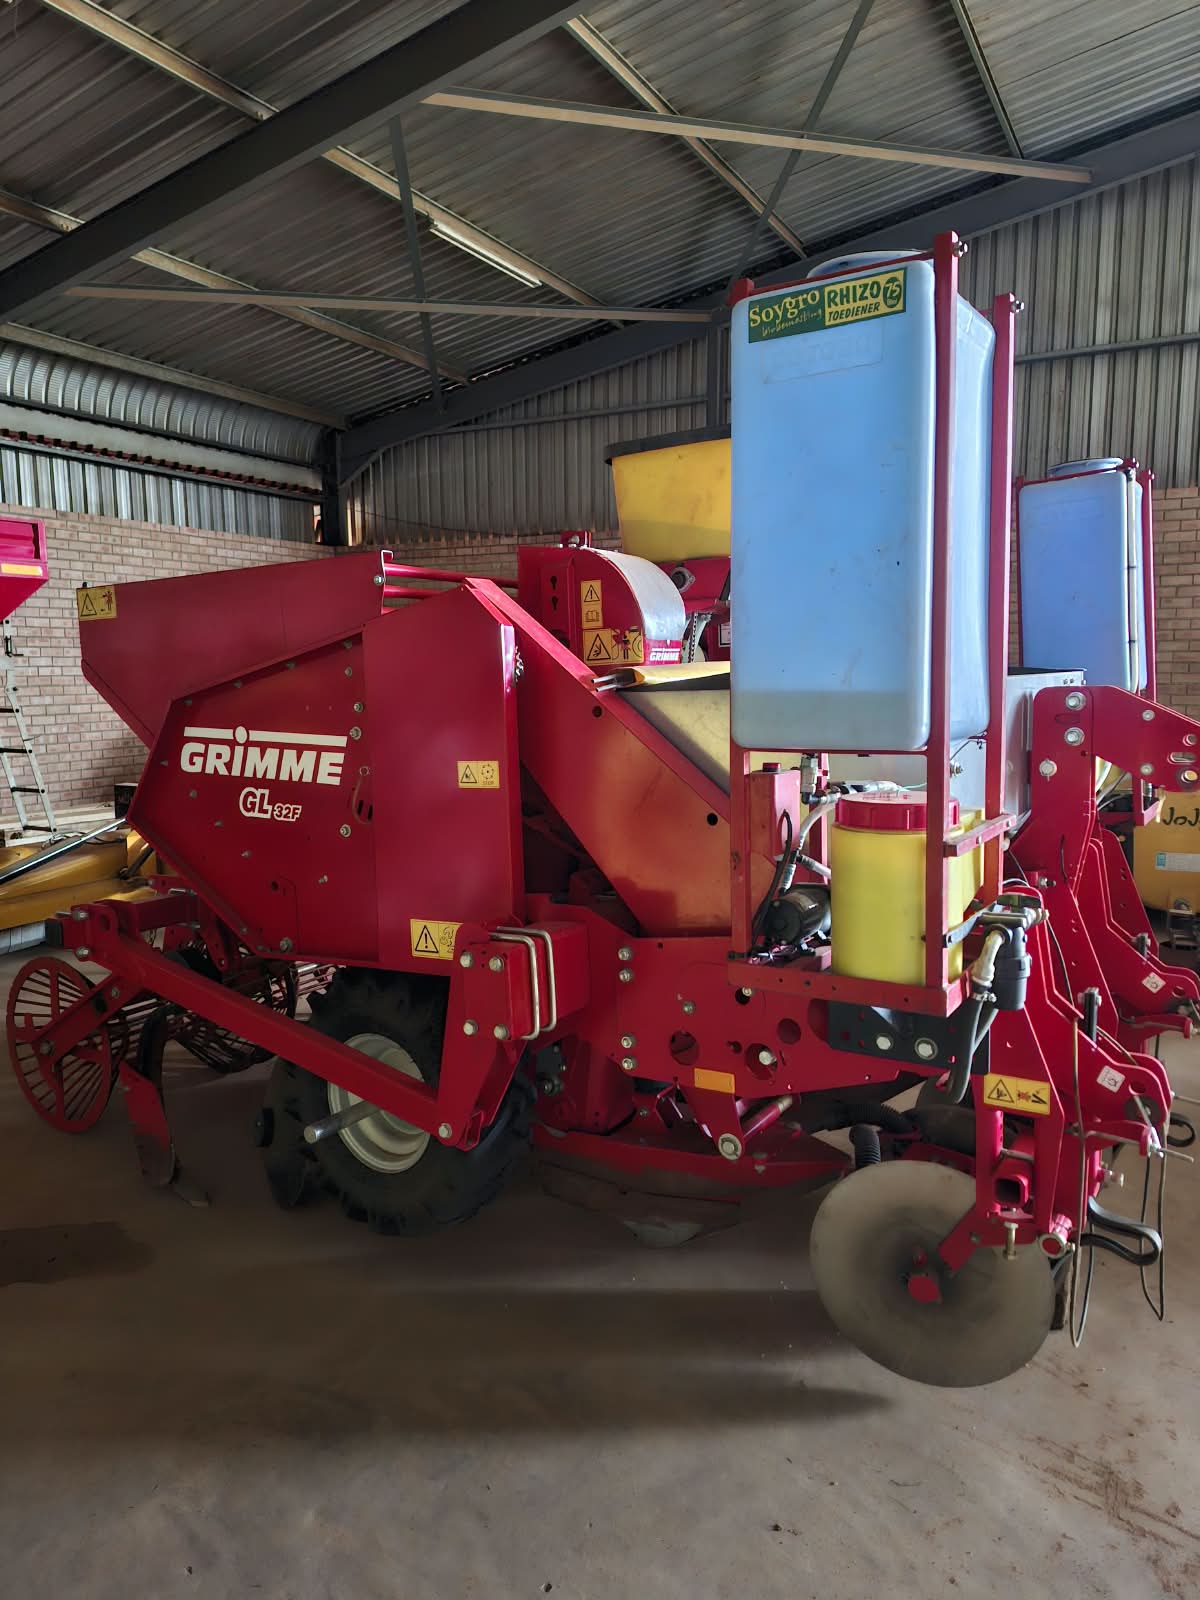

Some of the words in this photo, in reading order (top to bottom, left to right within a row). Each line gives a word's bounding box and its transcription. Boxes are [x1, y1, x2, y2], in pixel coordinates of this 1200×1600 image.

[749, 290, 820, 327] Soygro
[827, 280, 881, 309] RHIZO
[828, 302, 881, 322] TOEDIENER
[180, 726, 347, 785] GRIMME
[239, 787, 272, 819] GL
[273, 803, 302, 822] 32F
